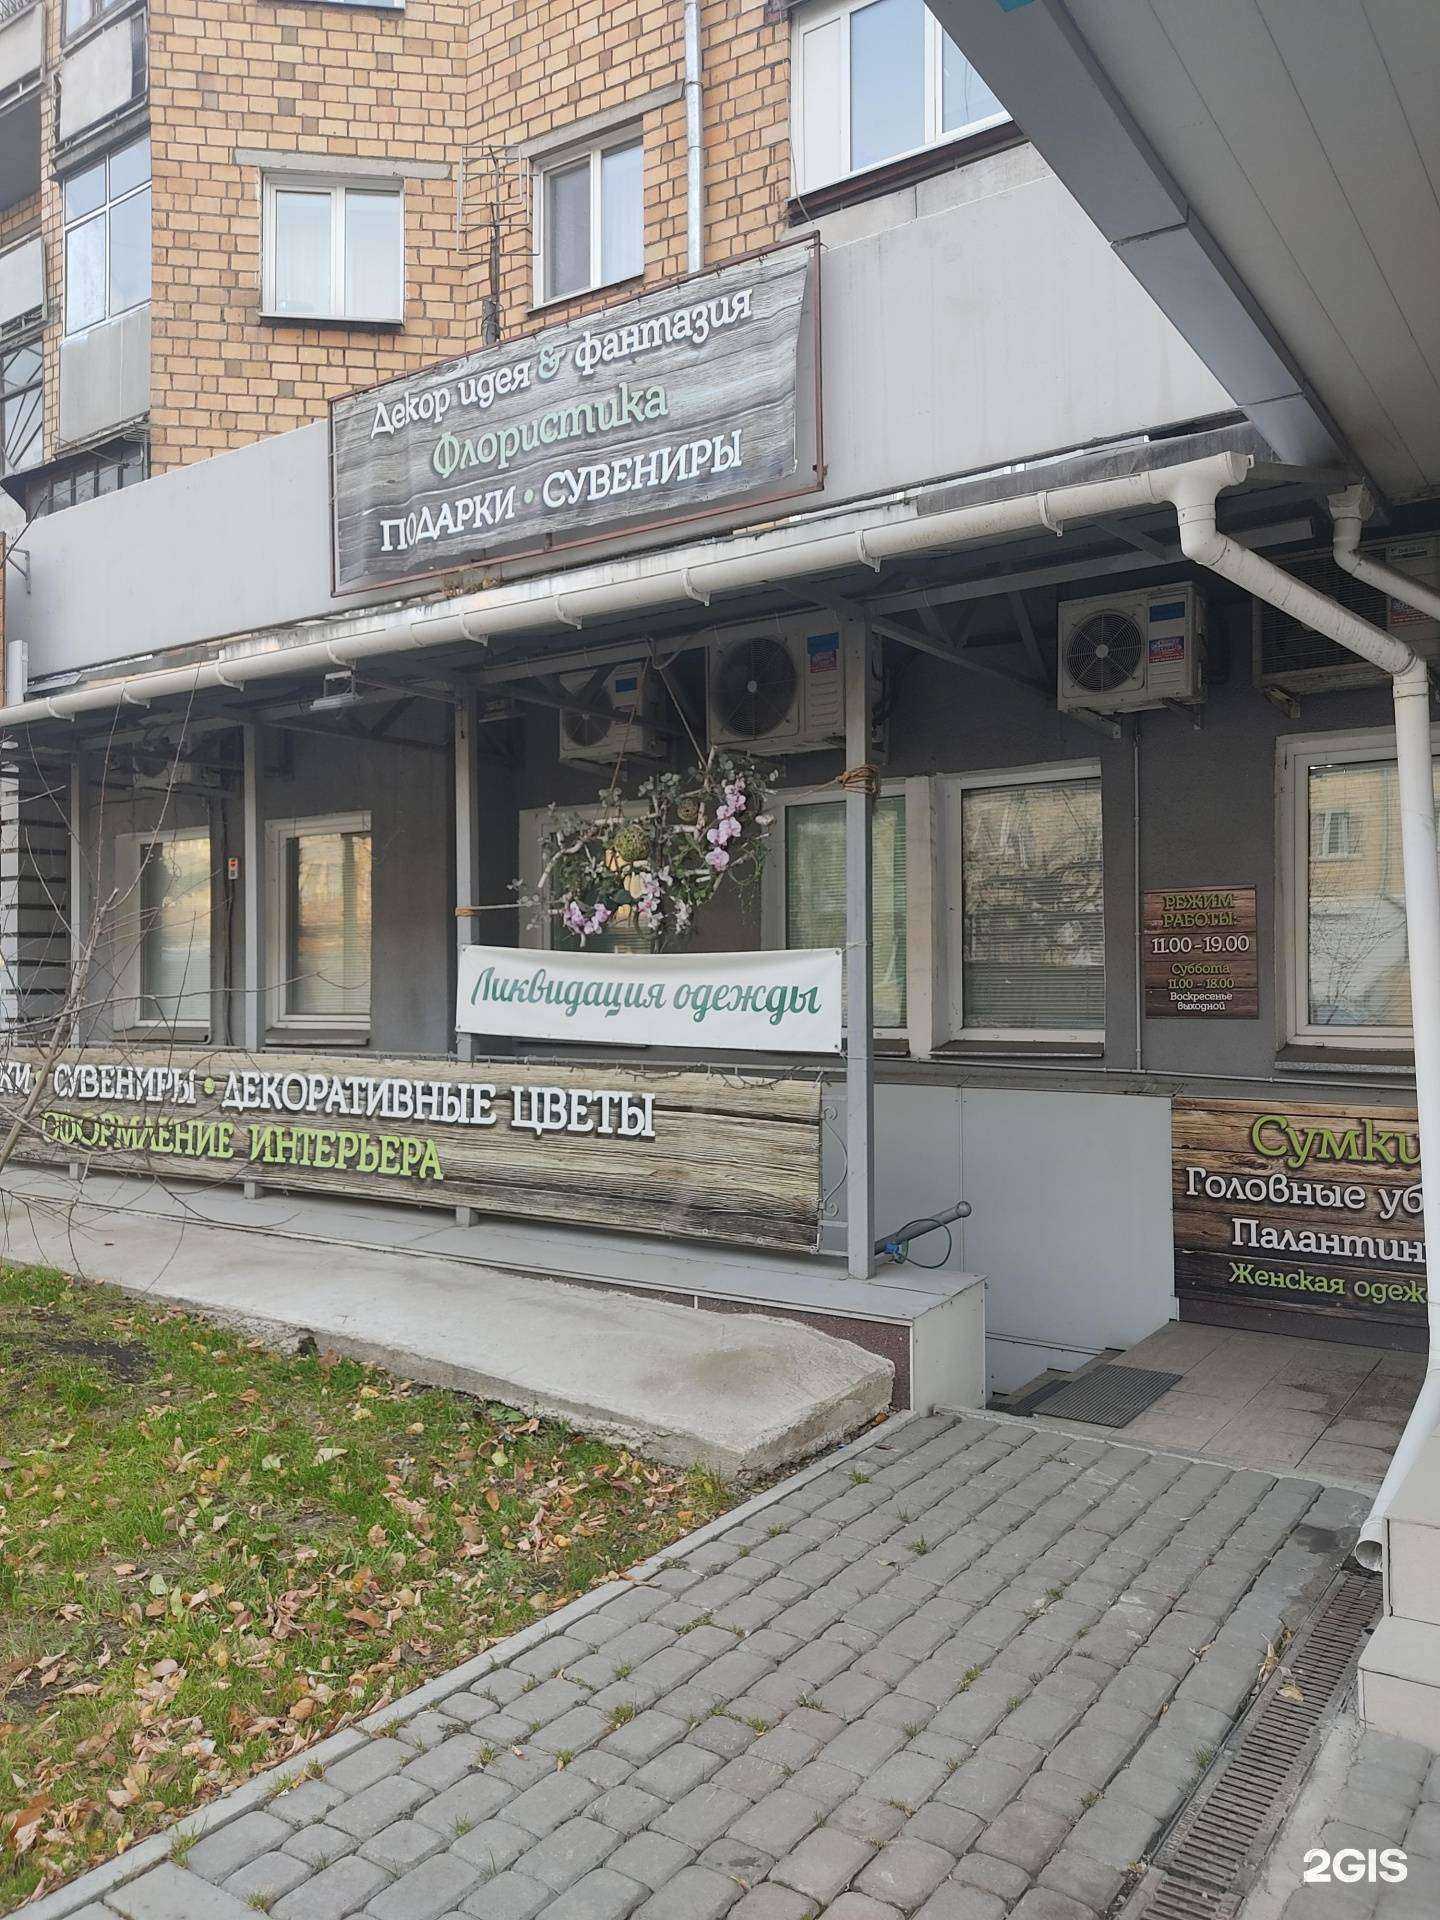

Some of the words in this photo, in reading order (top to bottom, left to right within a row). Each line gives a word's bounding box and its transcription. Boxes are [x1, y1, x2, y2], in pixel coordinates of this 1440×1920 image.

[370, 389, 451, 440] Декор
[458, 358, 532, 409] идея
[537, 342, 568, 380] &
[574, 287, 753, 377] фантазия
[432, 381, 669, 479] Флористика
[379, 486, 518, 553] ПОДАРКИ
[542, 429, 744, 509] СУВЕНИРЫ
[1164, 894, 1234, 910] РЕЖИМ
[1171, 963, 1231, 976] Суббота
[1206, 978, 1235, 989] 18.00
[471, 966, 667, 1018] Ликвидация
[673, 983, 823, 1027] одежды
[1170, 991, 1233, 1003] Воскресенье
[1177, 1001, 1226, 1012] выходной
[53, 1063, 197, 1104] СУВЕНИРЫ
[221, 1070, 497, 1126] ДЕКОРАТИВНЫЕ
[510, 1085, 657, 1138] ЦВЕТЫ
[41, 1109, 235, 1160] ОФОРМЛЕНИЕ
[246, 1122, 445, 1181] ИНТЕРЬЕРА
[1251, 1114, 1422, 1169] Сумки
[1185, 1166, 1366, 1210] Головные
[1232, 1218, 1426, 1263] Палантин
[1228, 1262, 1346, 1295] Женская
[1354, 1280, 1428, 1306] одеж
